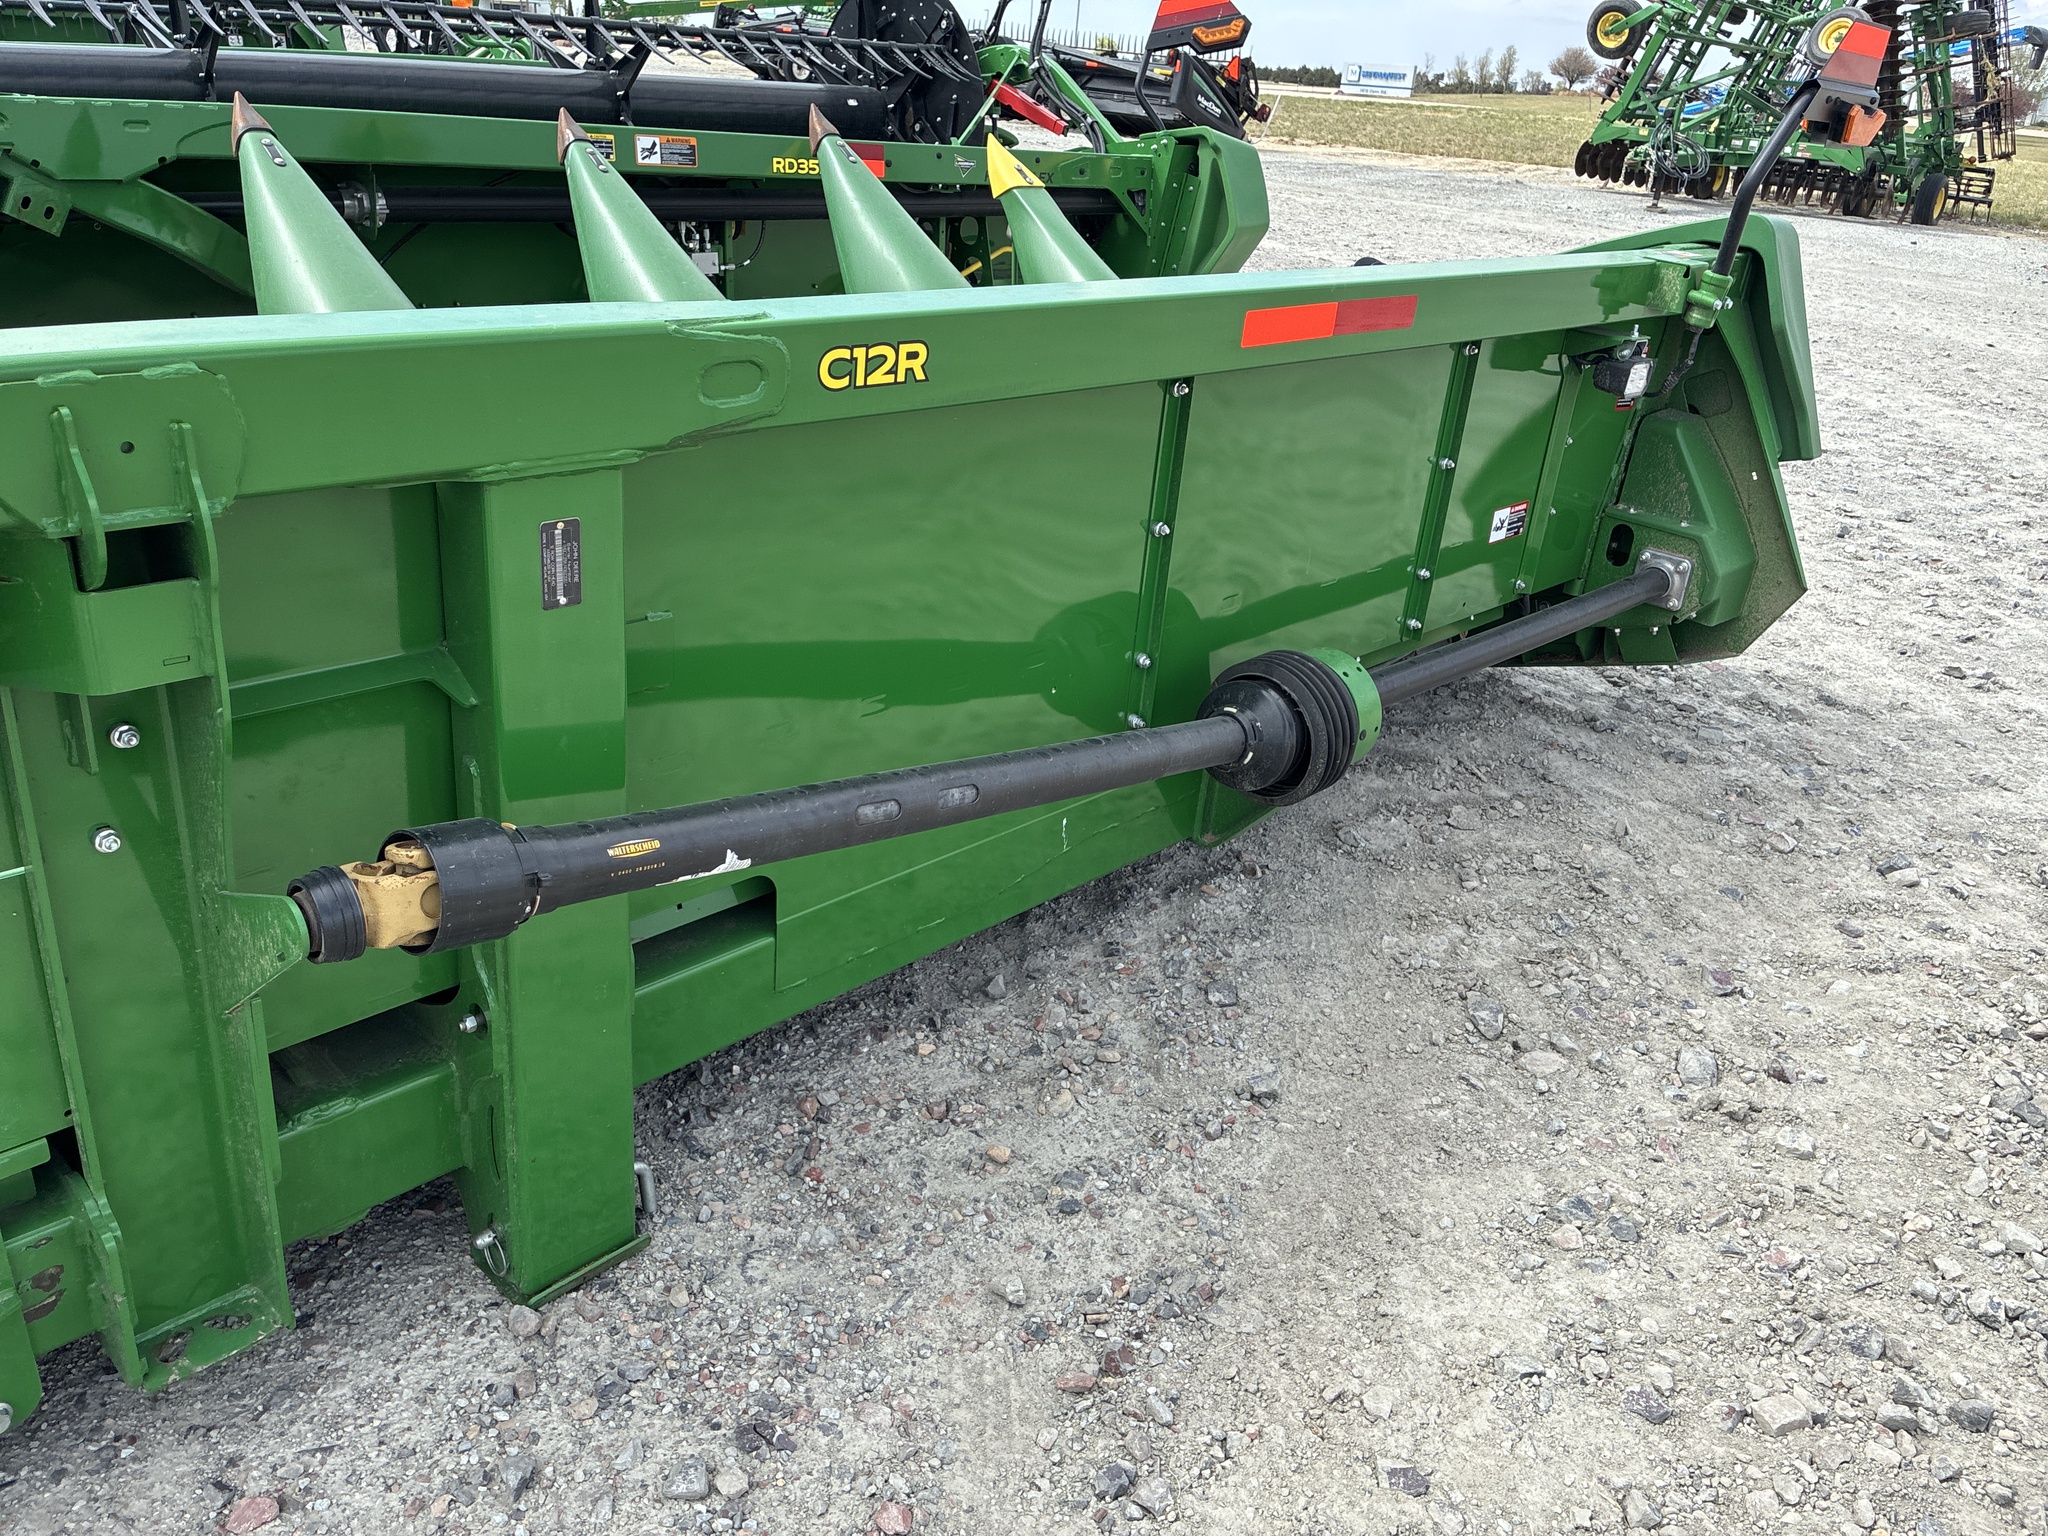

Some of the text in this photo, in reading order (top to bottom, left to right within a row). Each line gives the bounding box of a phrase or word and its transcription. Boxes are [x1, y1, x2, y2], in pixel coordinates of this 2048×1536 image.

[1197, 94, 1221, 114] MacDon
[772, 157, 820, 175] RD35
[817, 339, 929, 392] C12R
[606, 839, 661, 857] WALTERSCHEID
